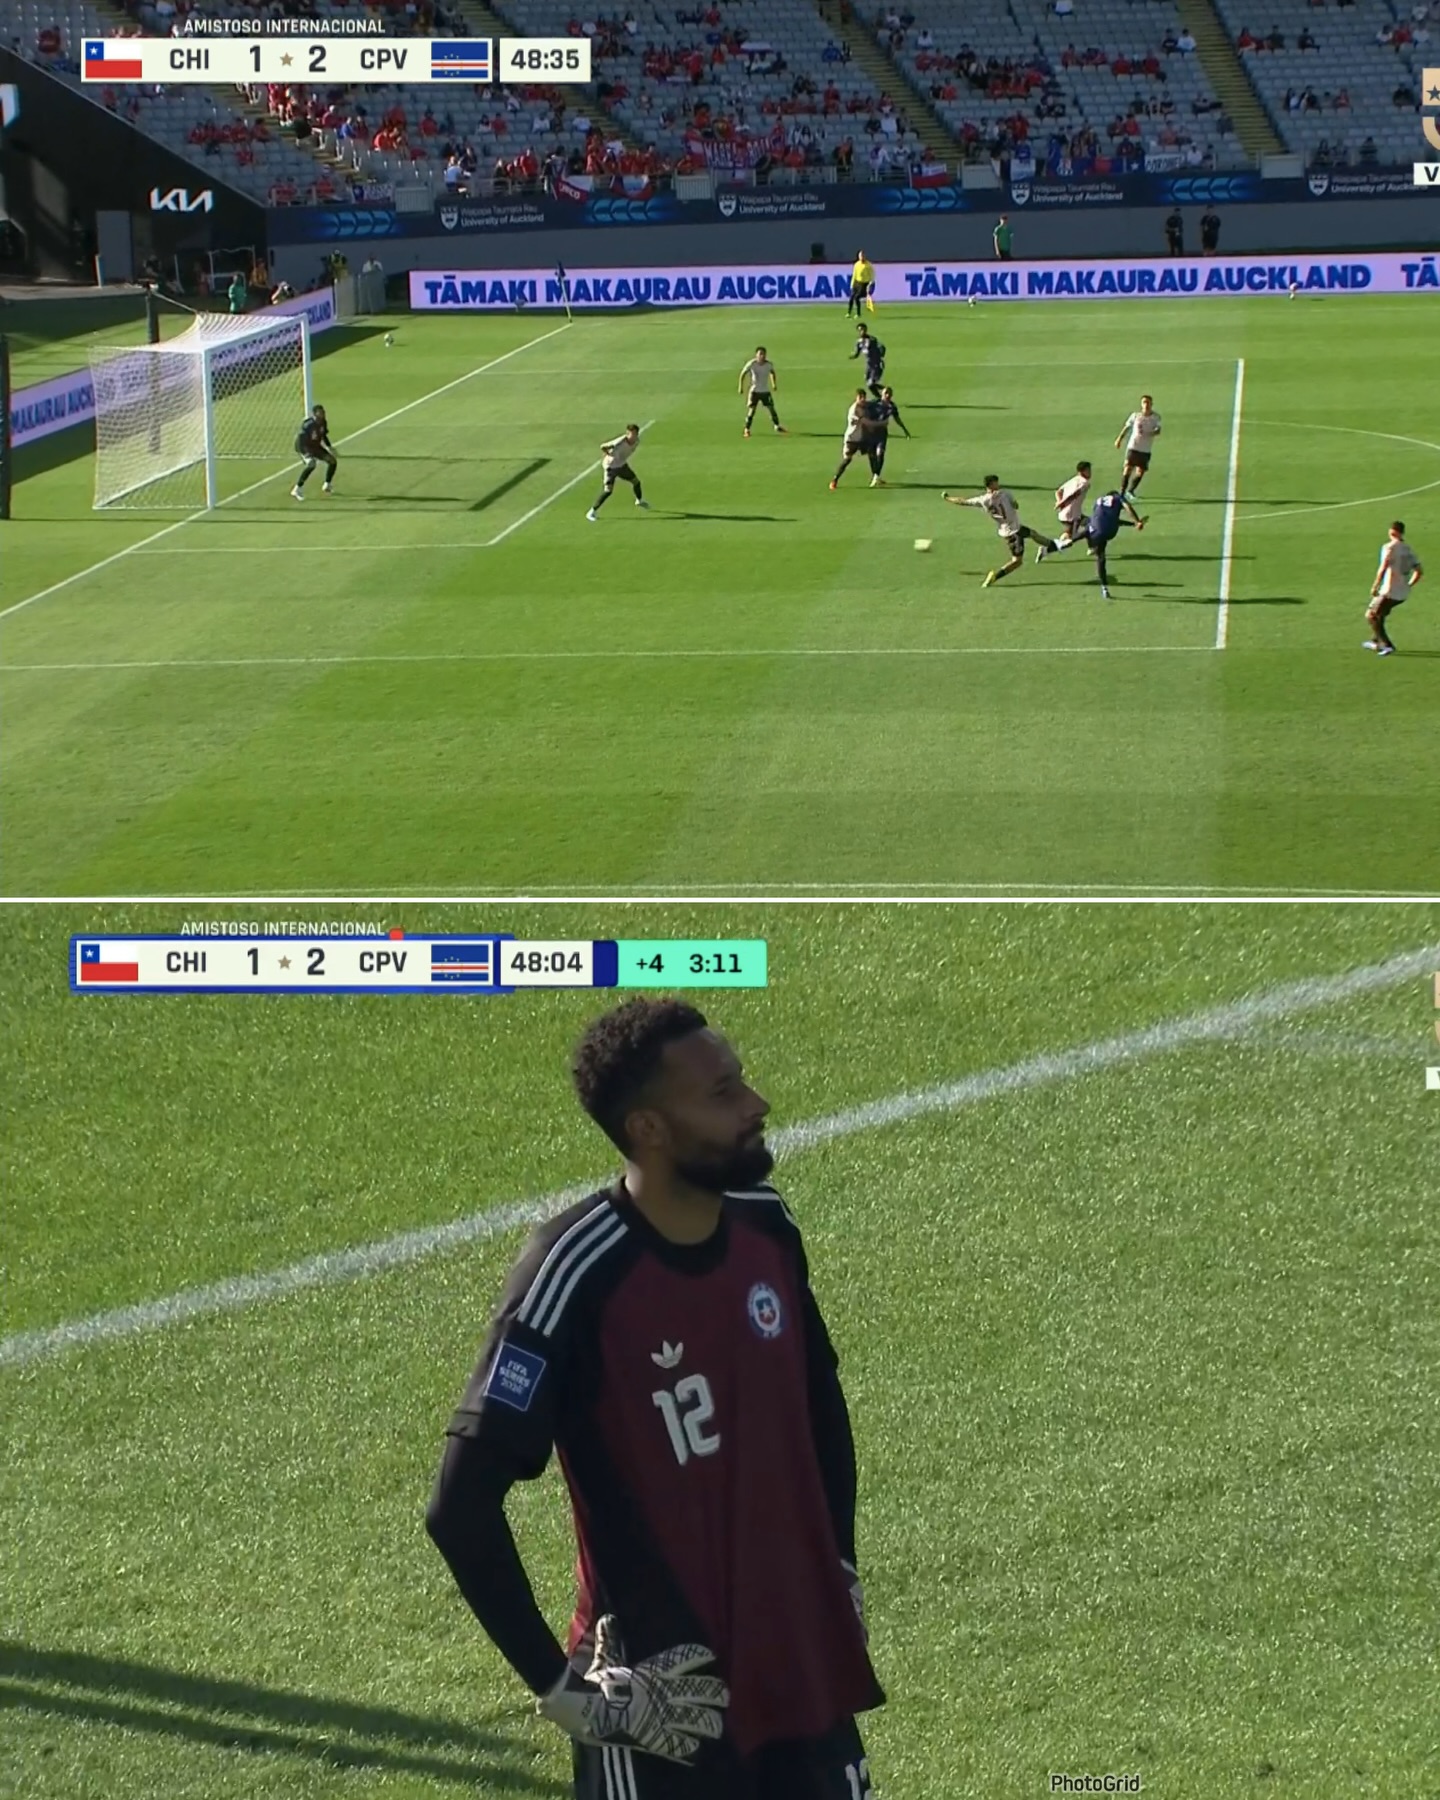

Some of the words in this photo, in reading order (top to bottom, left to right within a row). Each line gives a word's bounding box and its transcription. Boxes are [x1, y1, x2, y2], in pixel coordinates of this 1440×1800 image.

[150, 186, 214, 213] KIA
[739, 204, 779, 215] University
[779, 203, 788, 213] of
[789, 201, 825, 212] Auckland
[1033, 193, 1073, 204] University
[1074, 192, 1084, 202] of
[1085, 190, 1124, 201] Auckland
[461, 215, 499, 227] University
[499, 214, 508, 225] of
[509, 212, 545, 224] Auckland
[424, 275, 537, 305] TĀMAKI
[545, 276, 711, 304] MAKAURAU
[716, 274, 874, 300] AUCKLAN
[905, 266, 1019, 296] TĀMAKI
[1027, 267, 1198, 296] MAKAURAU
[1203, 263, 1372, 291] AUCKLAND
[507, 1359, 528, 1377] FIFA
[651, 1373, 721, 1466] 12
